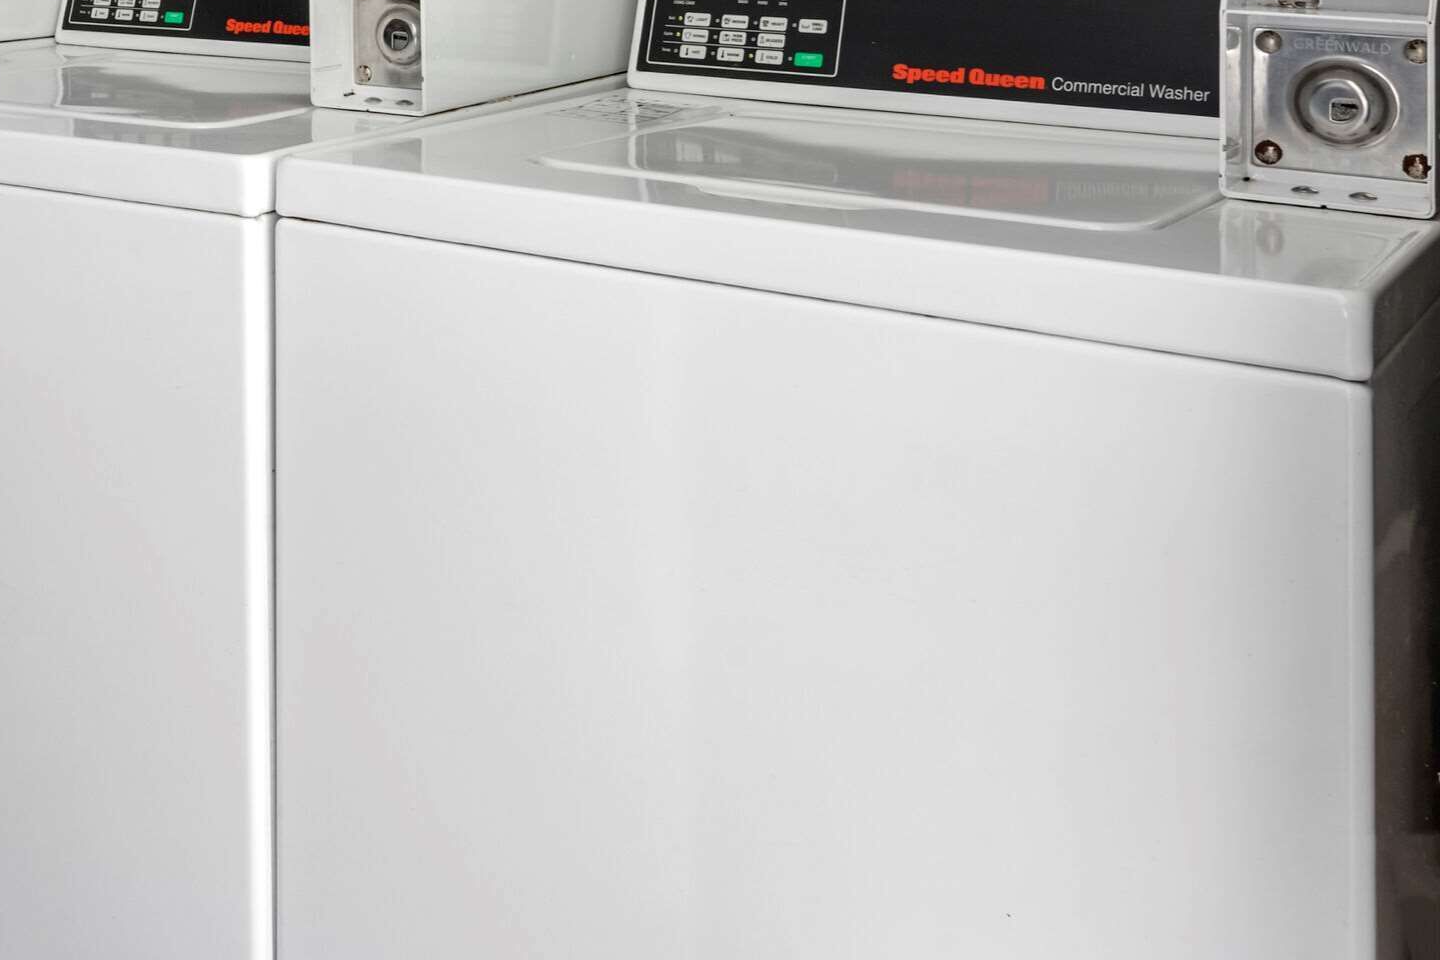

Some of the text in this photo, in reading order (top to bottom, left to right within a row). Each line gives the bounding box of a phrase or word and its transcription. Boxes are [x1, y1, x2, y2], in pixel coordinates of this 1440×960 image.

[226, 18, 311, 36] Speed Quee
[1294, 36, 1392, 55] GREENWALD
[892, 63, 1211, 102] Speed Queen Commercial Washer
